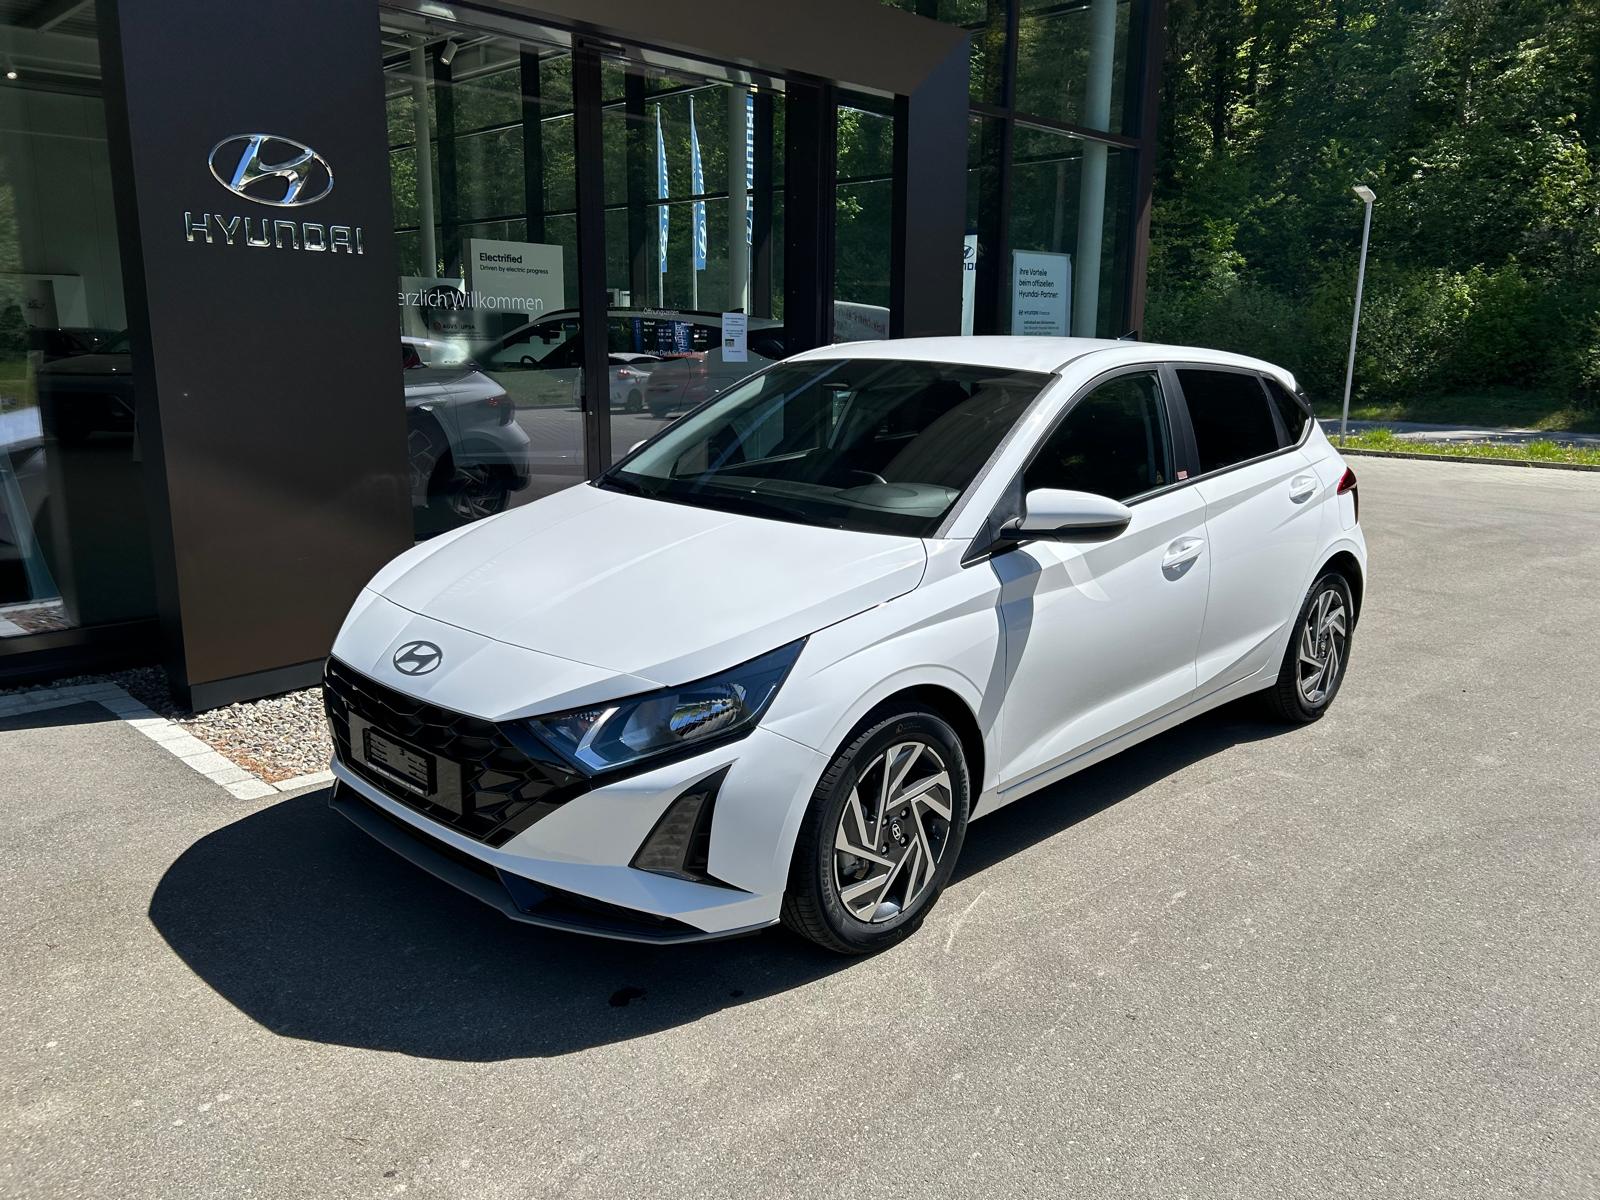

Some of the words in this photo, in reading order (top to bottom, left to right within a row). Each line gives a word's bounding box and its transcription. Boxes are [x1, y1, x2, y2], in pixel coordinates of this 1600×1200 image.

[184, 212, 364, 254] HYUNDAI
[479, 252, 523, 264] Electrified
[499, 265, 505, 273] by
[506, 265, 525, 273] electric
[526, 267, 549, 275] progress
[1019, 267, 1029, 276] Ihre
[1029, 268, 1048, 277] Vorteile
[1018, 279, 1032, 287] beim
[1032, 280, 1054, 288] offiziellen
[450, 290, 544, 310] Willkommen
[643, 306, 680, 316] Öffnungszeiten
